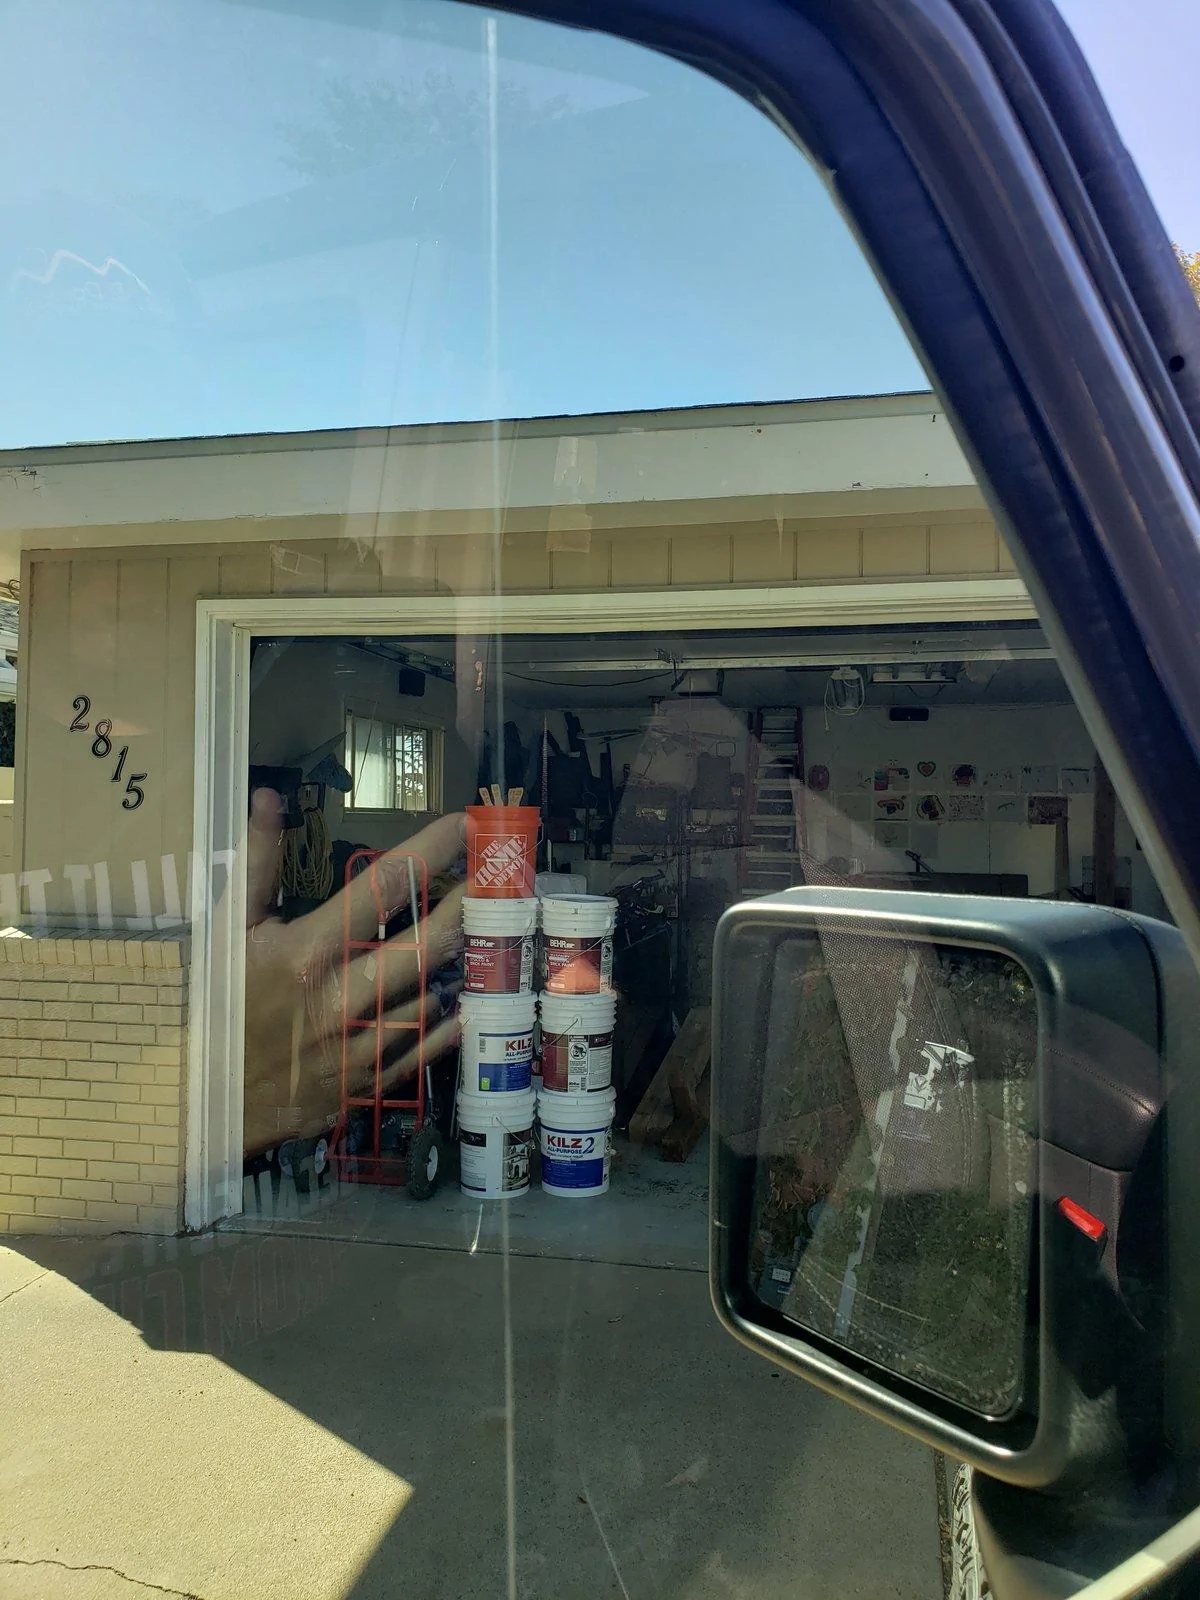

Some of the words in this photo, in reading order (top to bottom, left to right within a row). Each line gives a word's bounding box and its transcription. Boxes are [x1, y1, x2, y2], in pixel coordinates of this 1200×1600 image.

[69, 694, 148, 811] 2815
[475, 835, 526, 887] HOME
[479, 840, 502, 860] THE
[493, 854, 526, 887] DEPOT
[505, 1038, 533, 1051] KILZ
[547, 1135, 582, 1148] KILZ
[583, 1137, 595, 1154] 2
